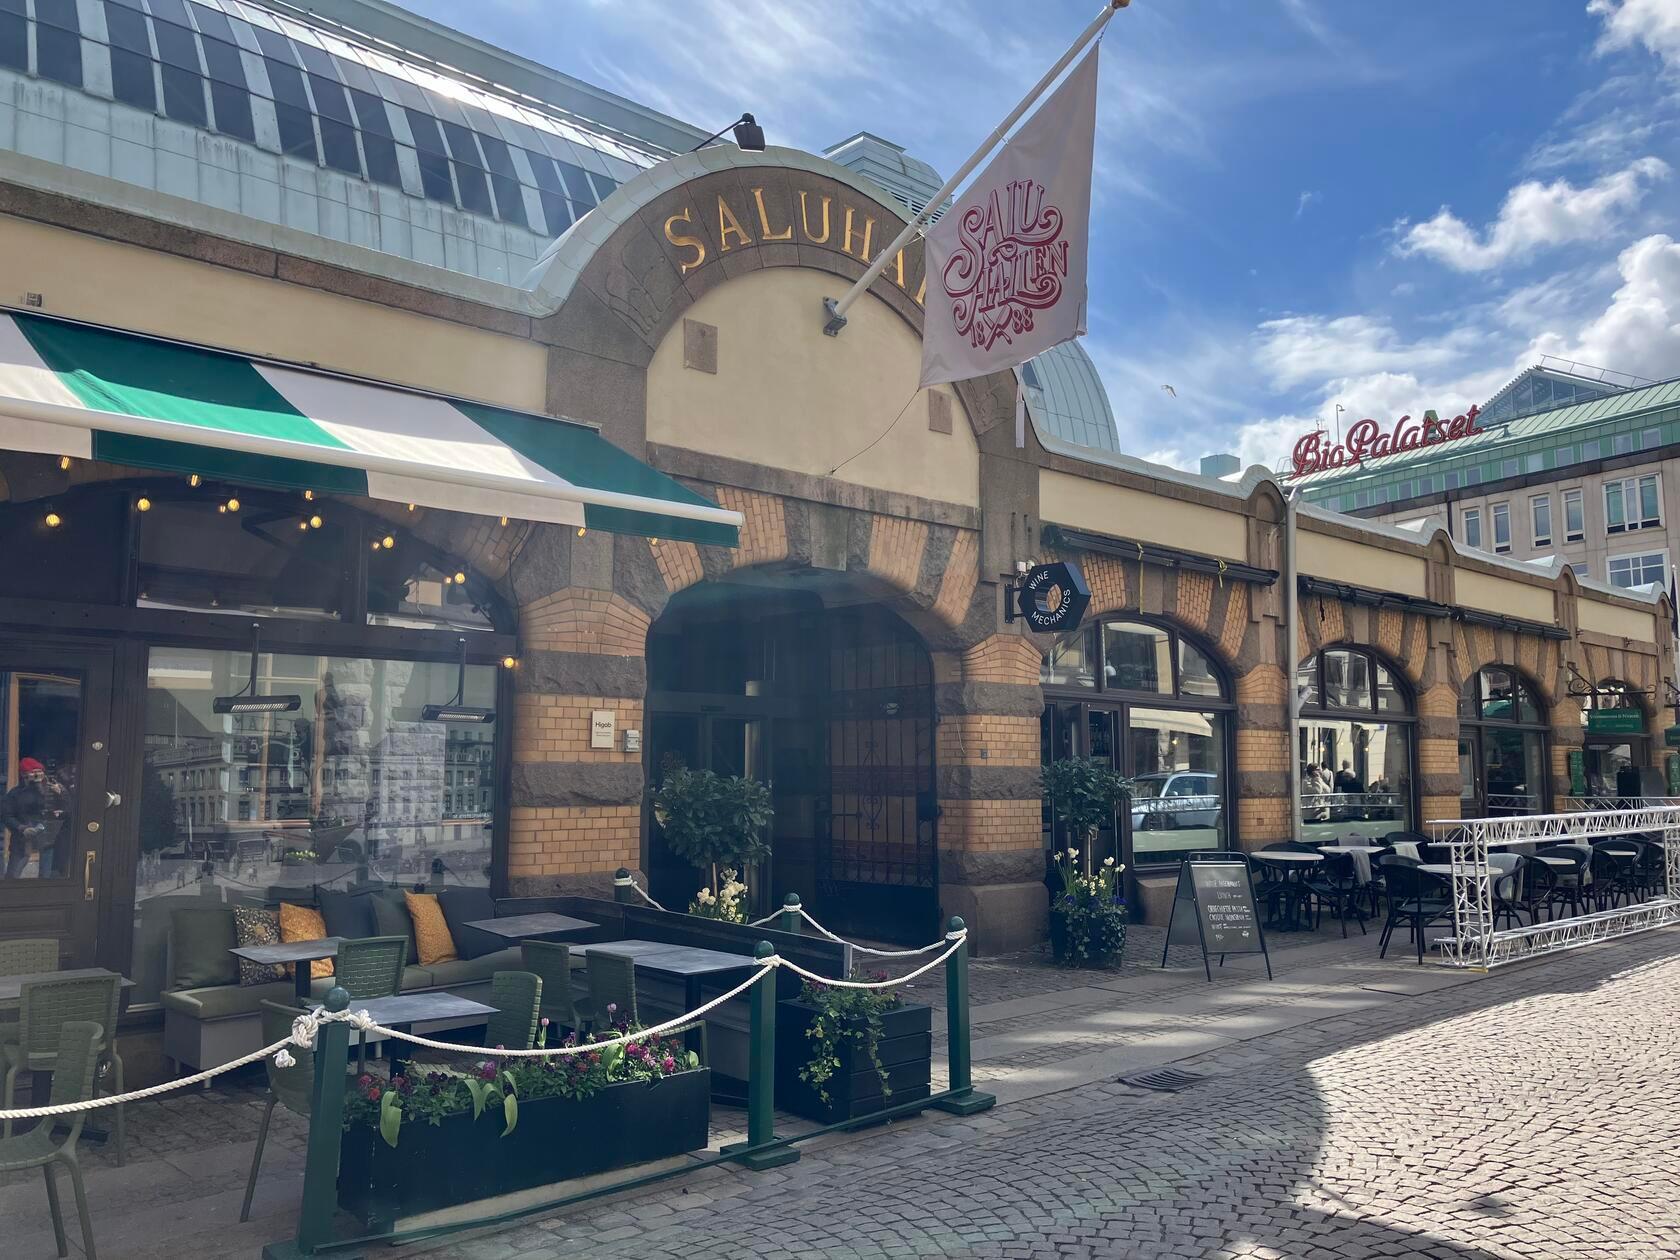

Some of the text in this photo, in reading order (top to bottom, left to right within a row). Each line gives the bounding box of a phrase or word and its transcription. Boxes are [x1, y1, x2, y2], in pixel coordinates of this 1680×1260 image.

[1288, 404, 1484, 481] Bio Palatset
[1029, 570, 1049, 590] WINE
[1031, 589, 1071, 625] MECHANICS
